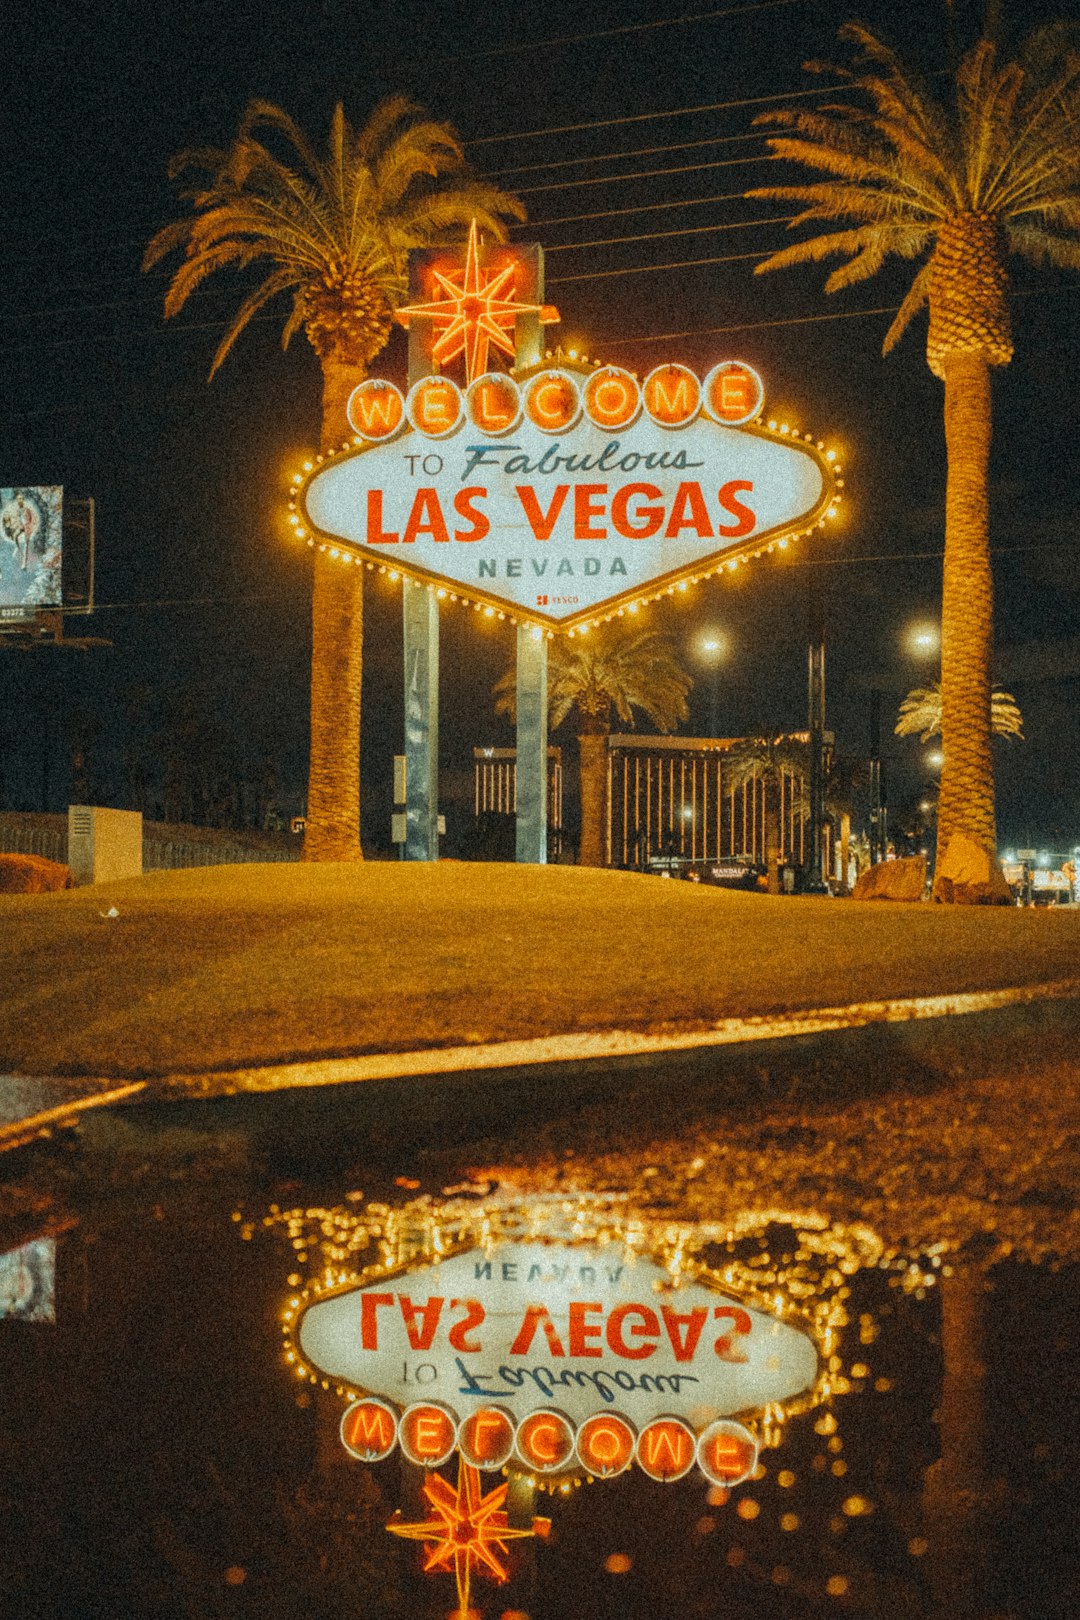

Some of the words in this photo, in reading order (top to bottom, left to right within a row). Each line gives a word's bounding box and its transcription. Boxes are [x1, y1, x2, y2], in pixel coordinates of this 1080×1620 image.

[358, 374, 748, 430] WELCOME
[403, 453, 444, 477] TO
[460, 440, 704, 482] Fabulous
[366, 486, 491, 544] LAS
[515, 479, 757, 541] VEGAS
[478, 556, 629, 579] NEVADA
